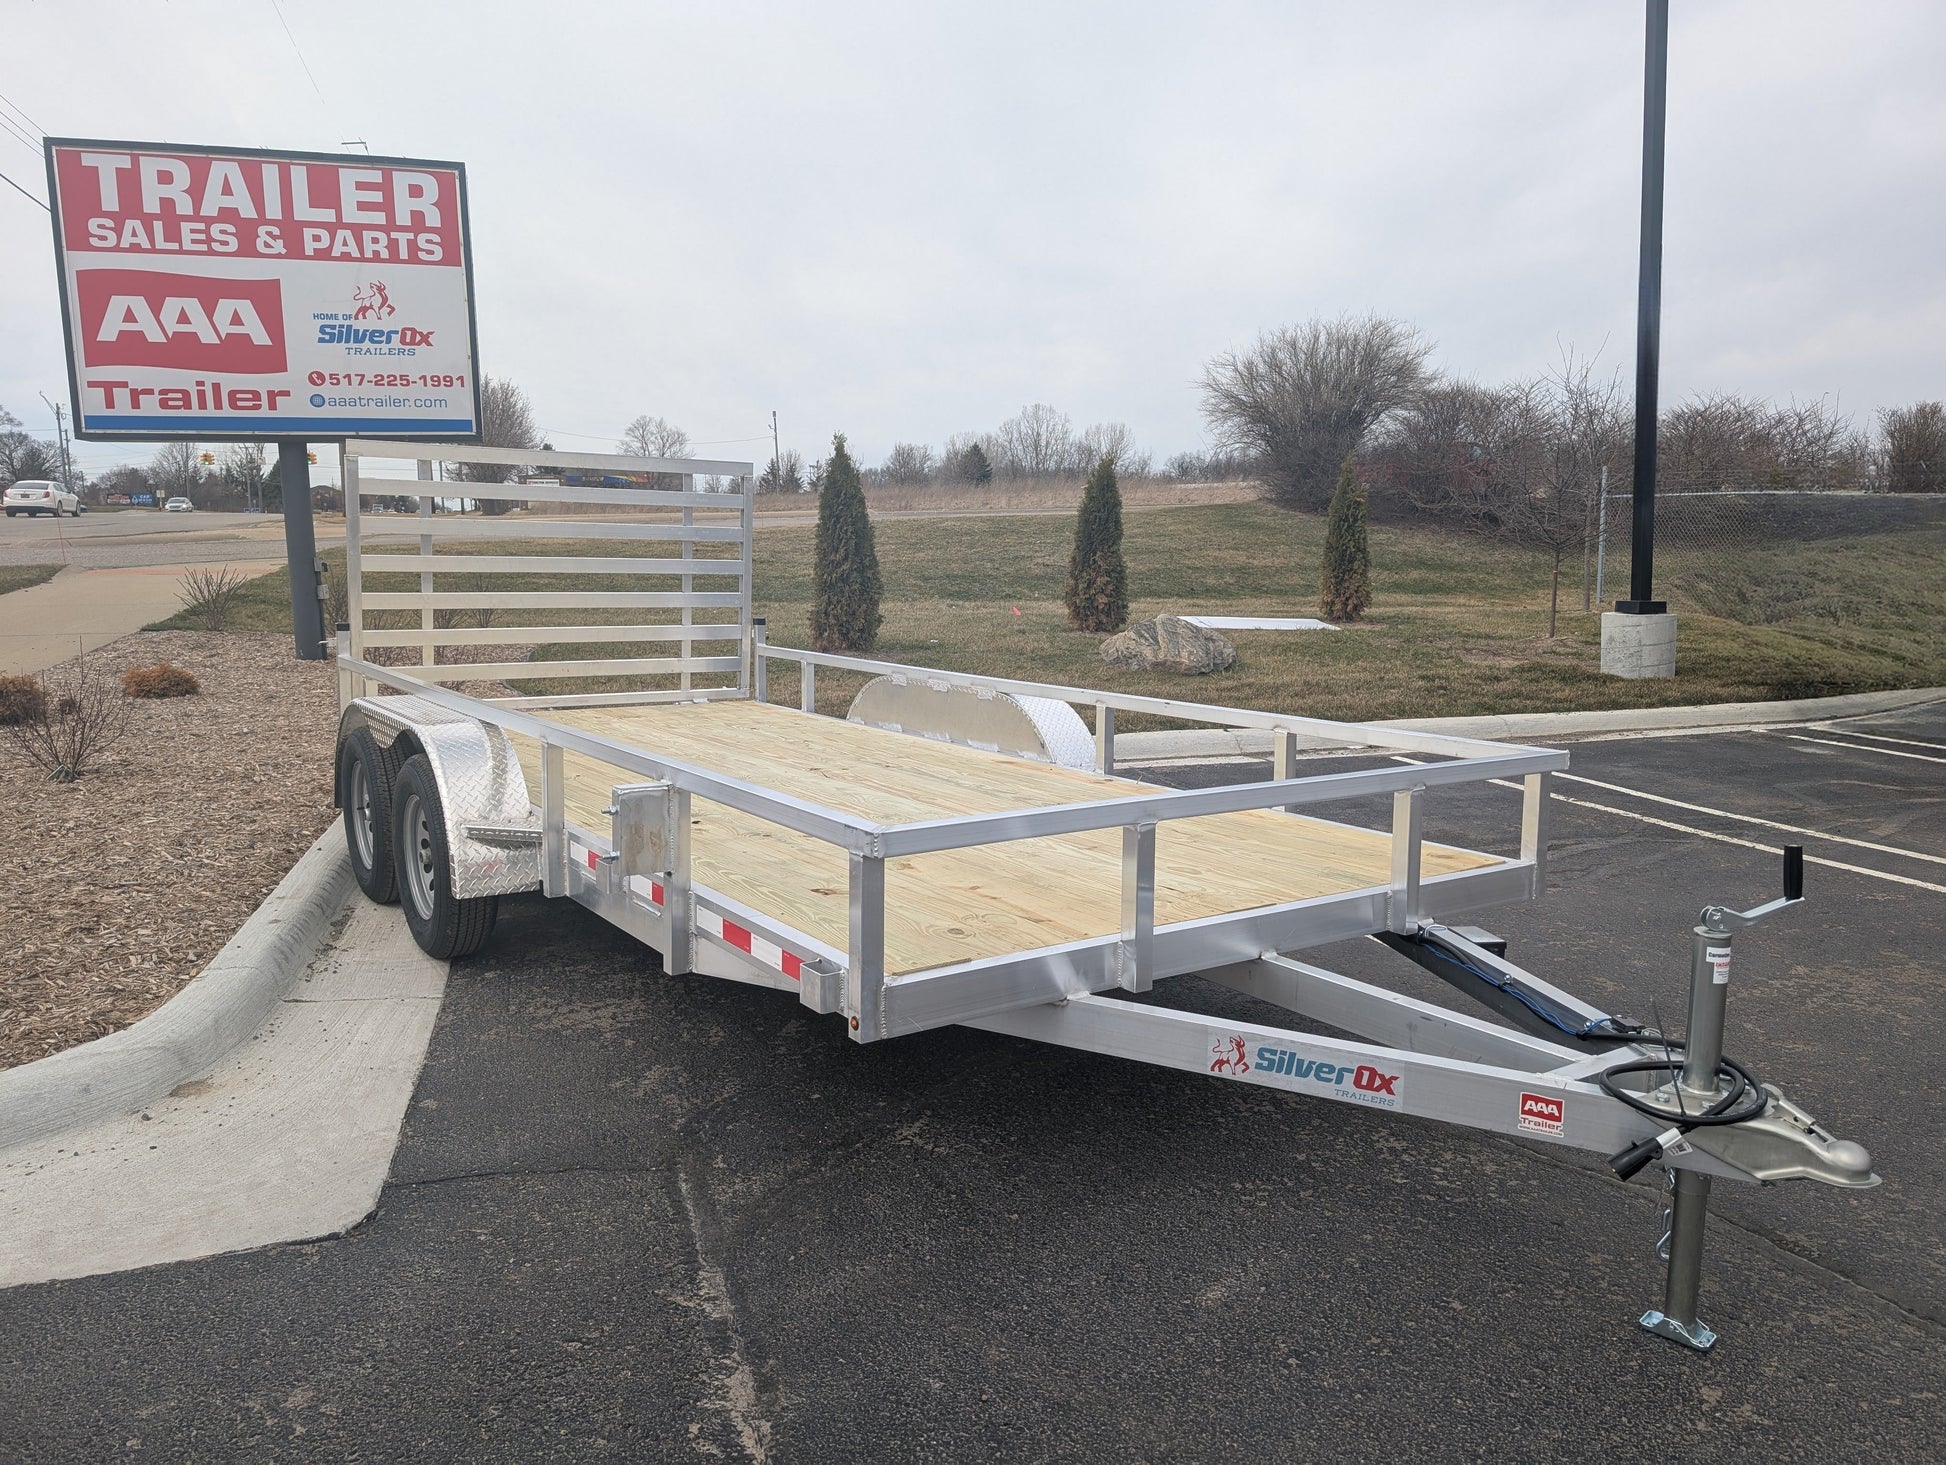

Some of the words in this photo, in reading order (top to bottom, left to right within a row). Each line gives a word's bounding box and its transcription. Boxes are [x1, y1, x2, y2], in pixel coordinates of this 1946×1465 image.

[80, 152, 442, 228] TRAILER
[87, 217, 239, 254] SALES
[256, 225, 287, 255] &
[303, 227, 444, 262] PARTS
[96, 295, 273, 346] AAA
[312, 312, 339, 321] HOME
[342, 313, 354, 321] OF
[345, 347, 416, 356] TRAILERS
[328, 373, 466, 388] 517-225-1991
[86, 380, 292, 411] Trailer
[327, 394, 449, 409] aaatrailer.com
[1334, 1088, 1395, 1107] TRAILERS
[1523, 1100, 1560, 1117] AAA
[1519, 1117, 1562, 1131] Trailer
